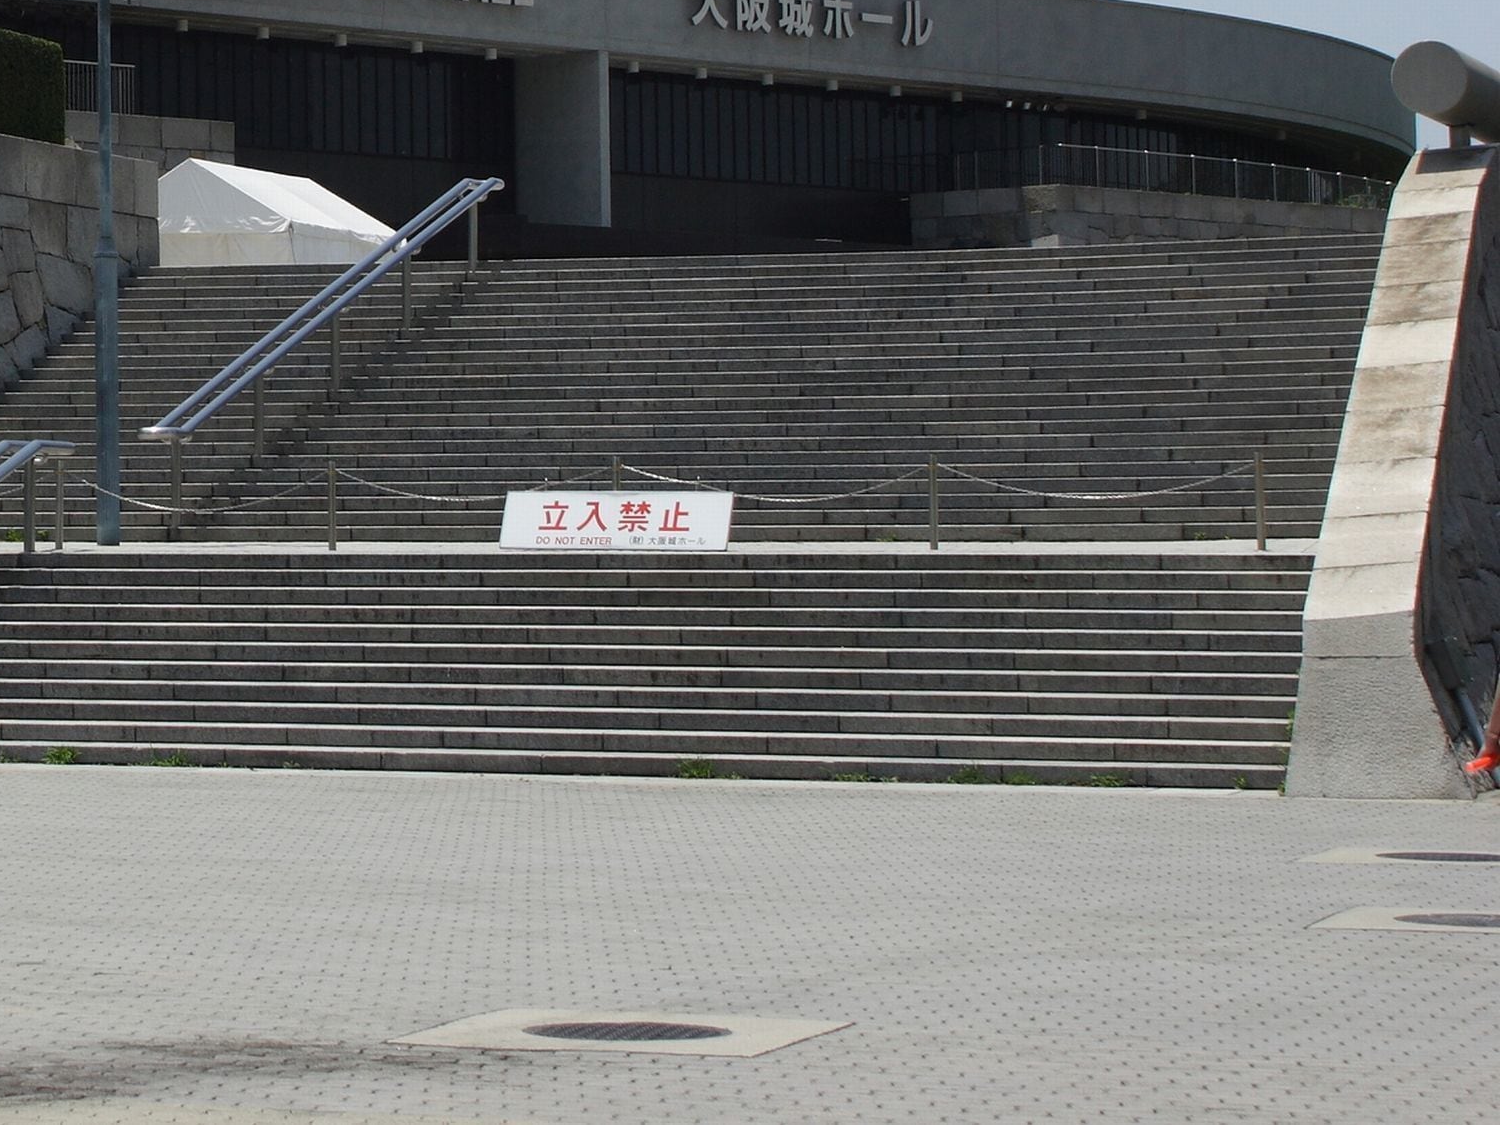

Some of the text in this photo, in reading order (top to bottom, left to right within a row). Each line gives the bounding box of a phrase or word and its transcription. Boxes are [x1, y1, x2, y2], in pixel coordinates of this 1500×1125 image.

[538, 501, 690, 532] 立入禁止
[535, 536, 613, 546] DO NOT ENTER
